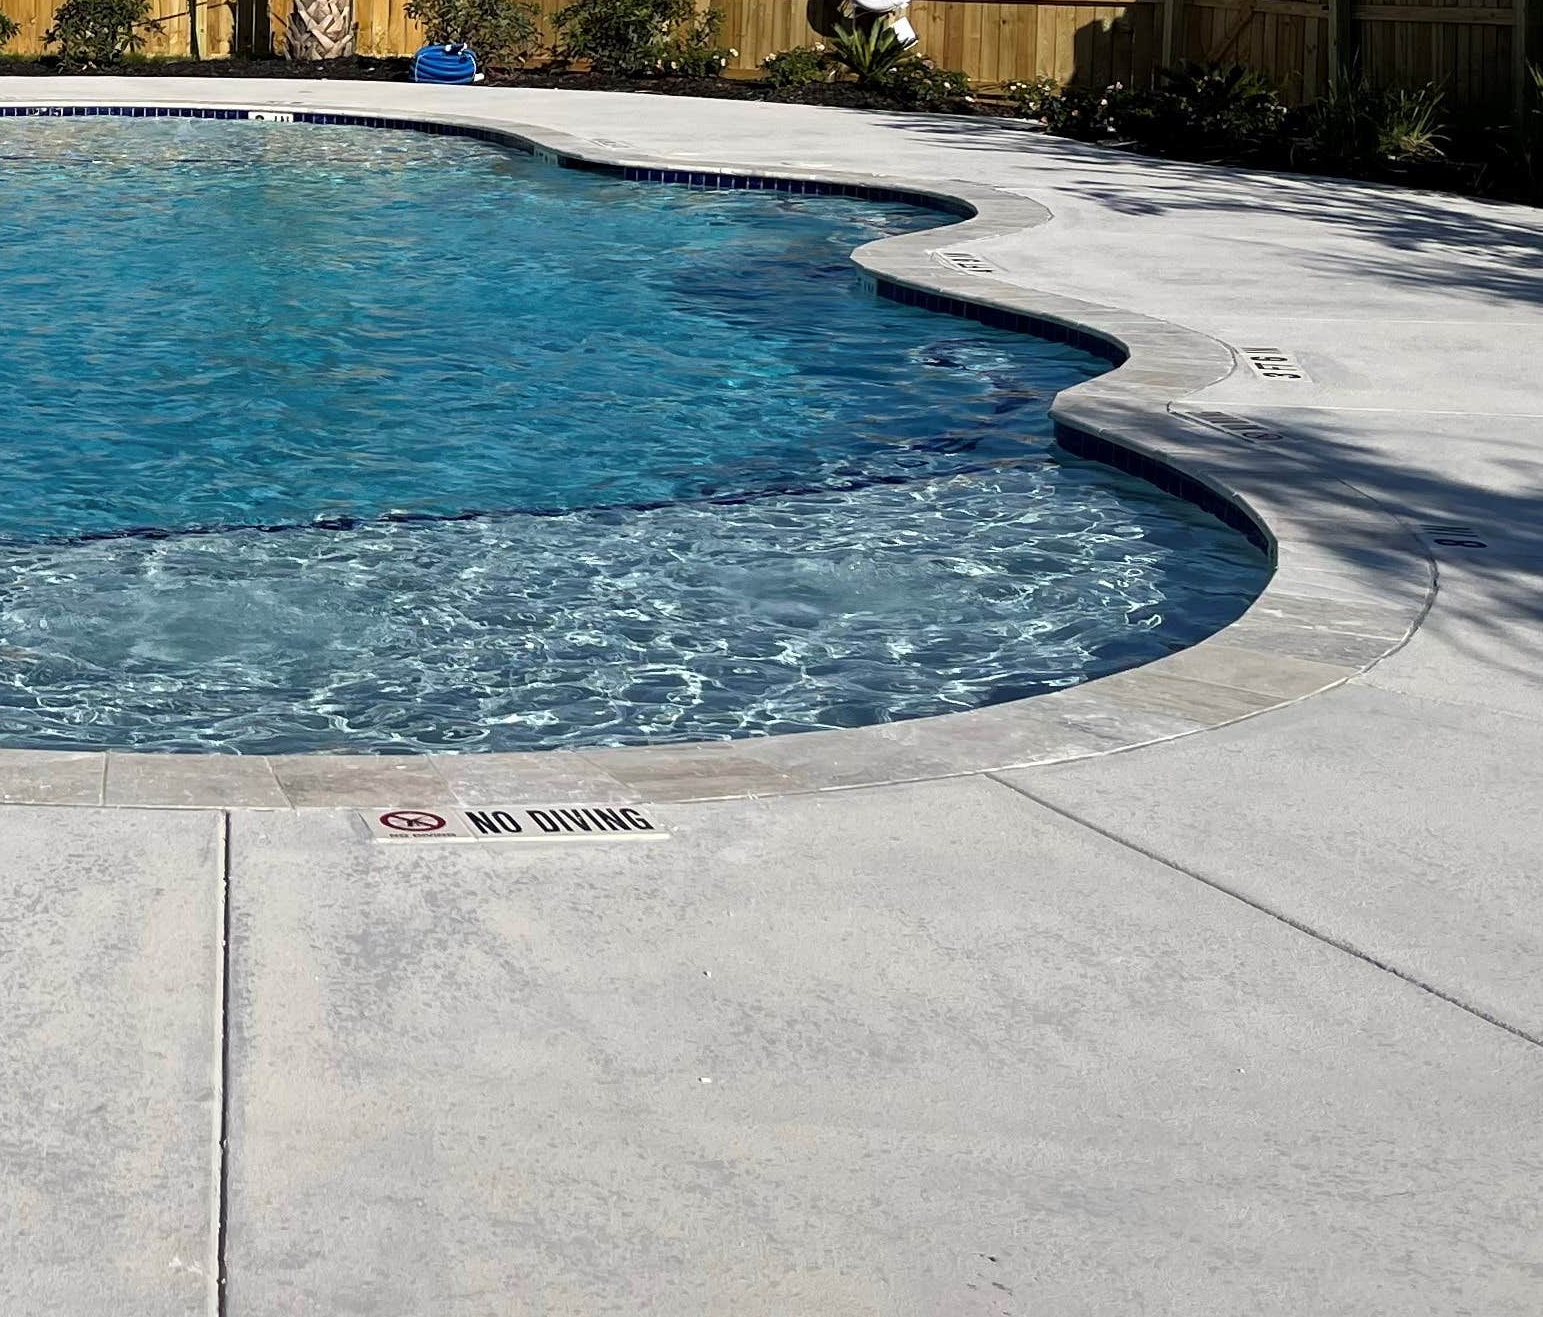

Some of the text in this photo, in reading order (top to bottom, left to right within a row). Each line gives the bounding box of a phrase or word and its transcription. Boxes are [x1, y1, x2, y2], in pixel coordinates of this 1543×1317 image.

[1418, 524, 1489, 549] 8 IN
[465, 808, 655, 834] NO DIVING
